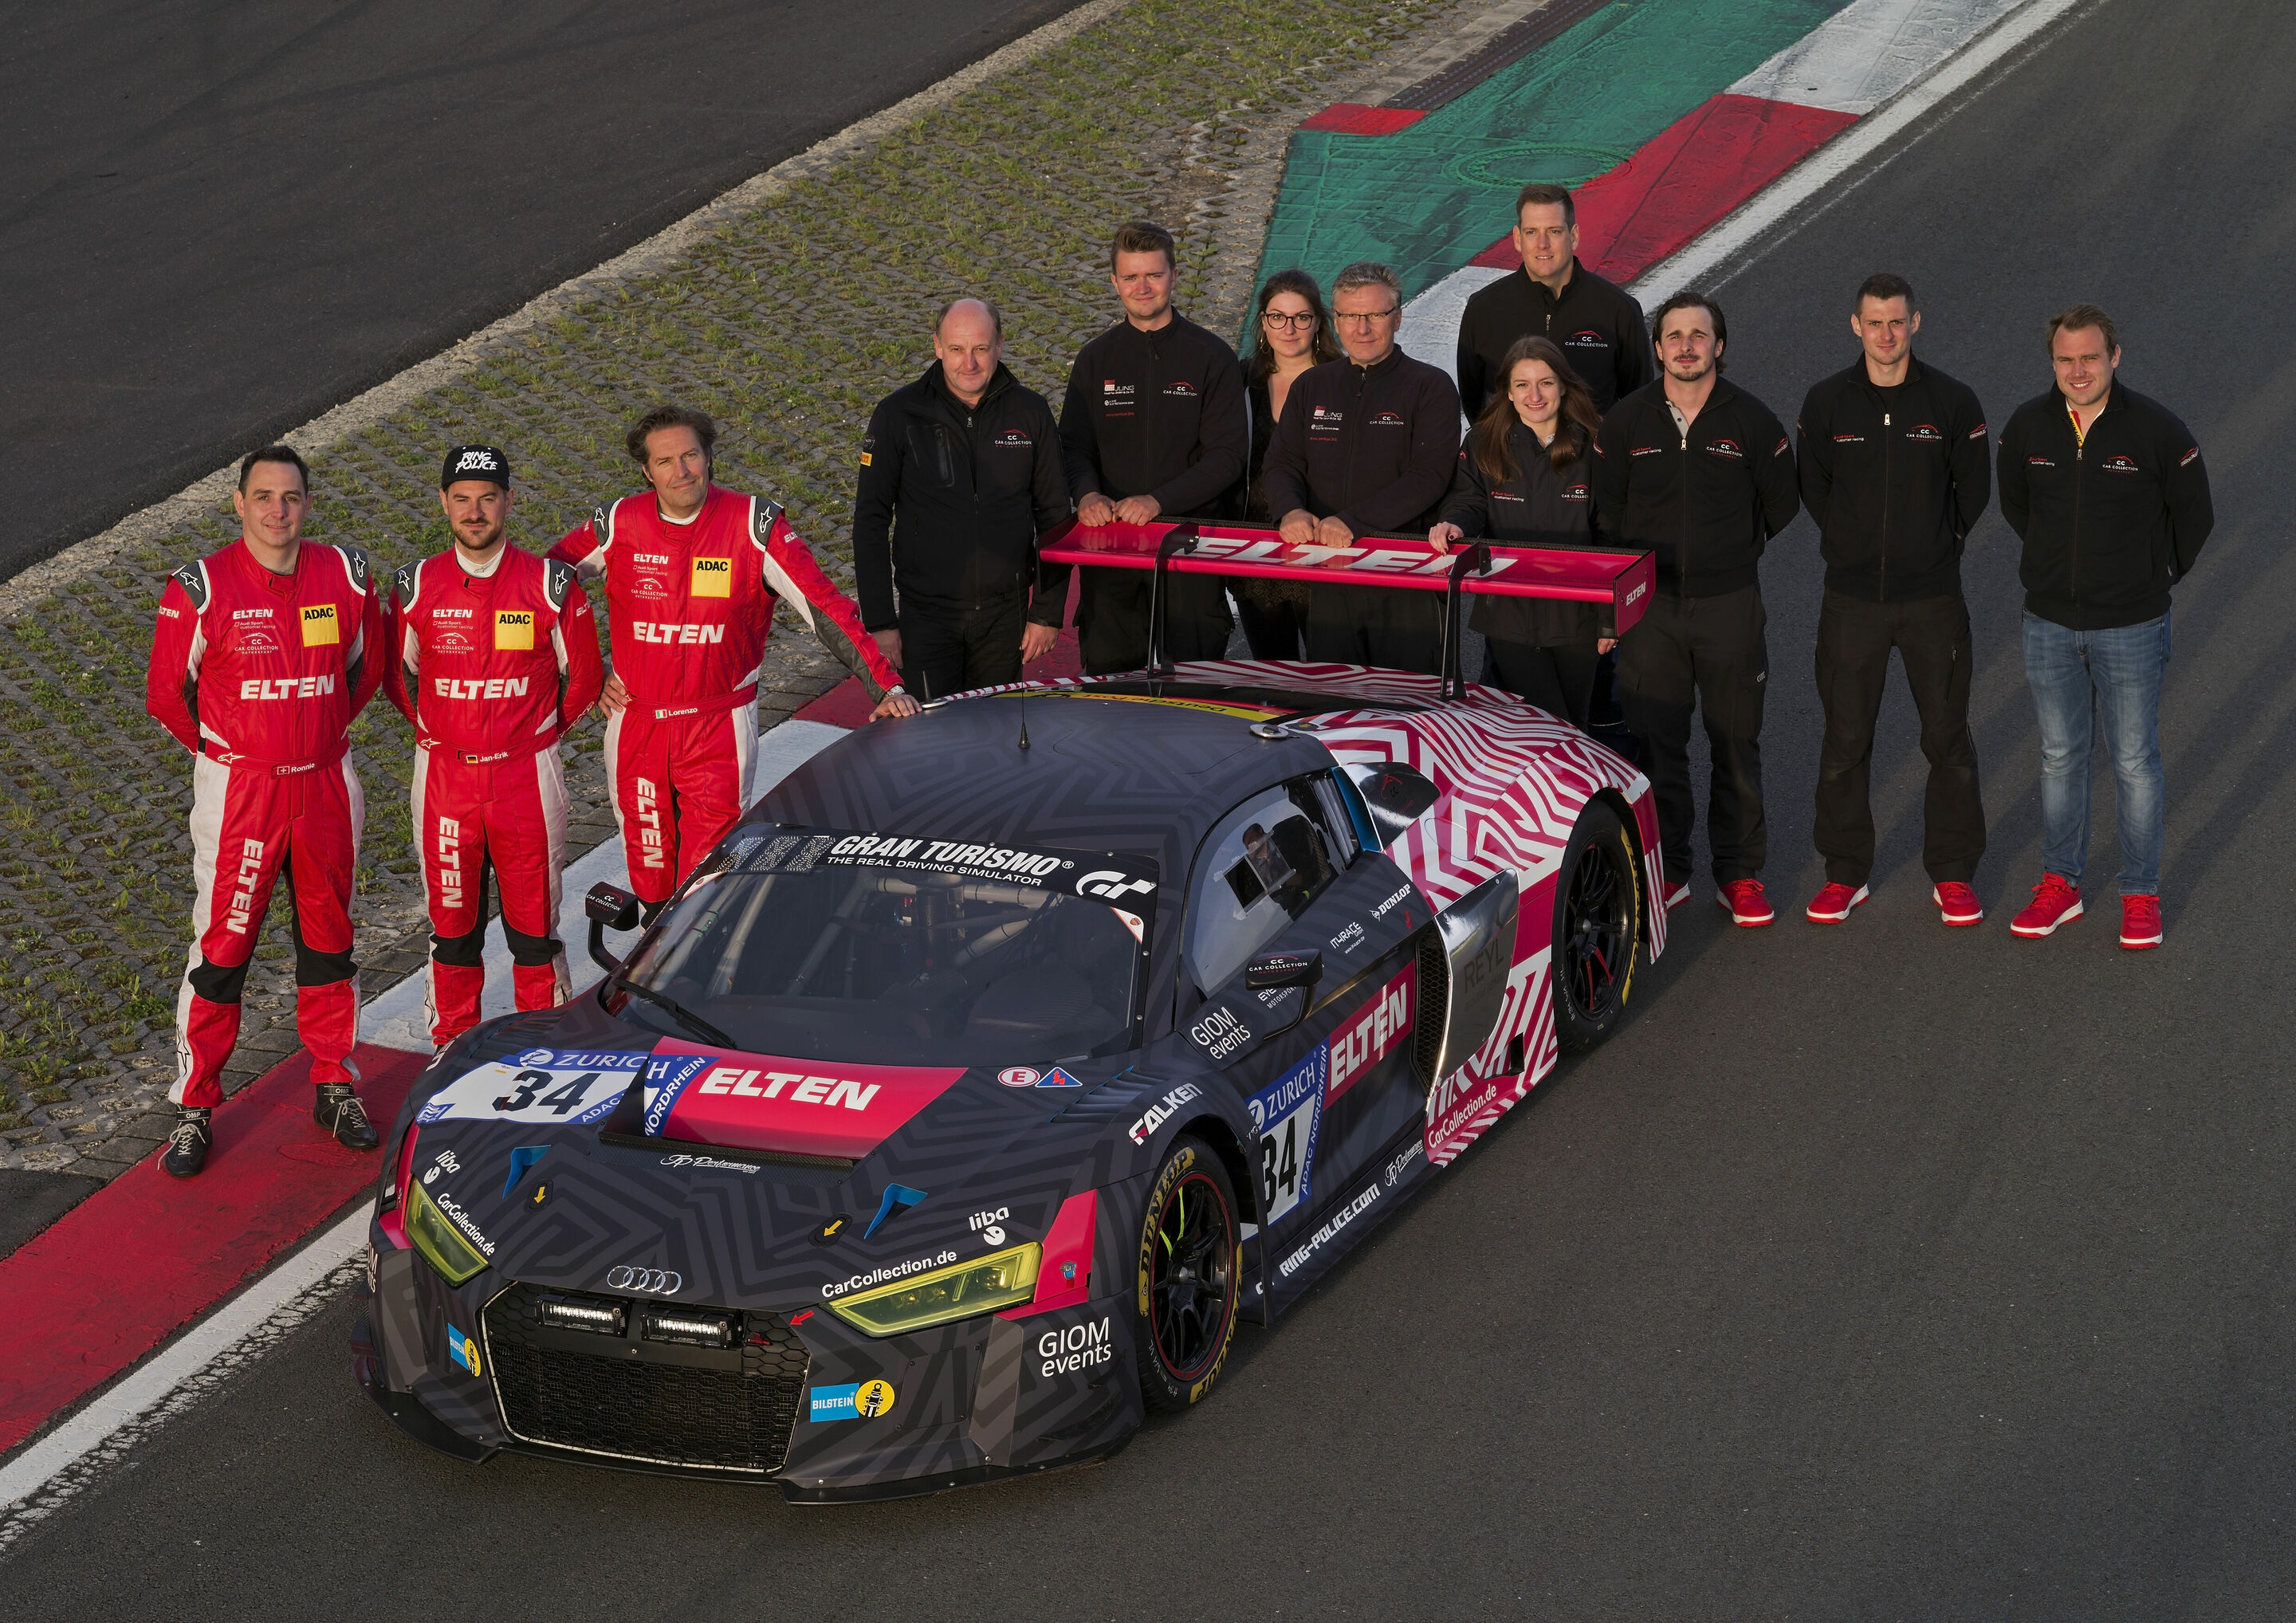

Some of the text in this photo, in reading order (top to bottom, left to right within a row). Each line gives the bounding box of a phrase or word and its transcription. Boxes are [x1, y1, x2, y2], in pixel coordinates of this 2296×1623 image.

[461, 451, 492, 463] RING
[1716, 448, 1743, 457] COLLECTION
[455, 460, 497, 474] POLICE
[633, 553, 669, 564] ELTEN
[696, 560, 729, 572] ADAC
[1626, 581, 1646, 607] ELTEN
[233, 609, 273, 620] ELTEN
[304, 607, 334, 621] ADAC
[433, 609, 473, 618] ELTEN
[498, 614, 531, 625] ADAC
[633, 621, 725, 644] ELTEN
[240, 674, 335, 700] ELTEN
[434, 677, 529, 700] ELTEN
[668, 706, 698, 717] Lorenzo
[291, 763, 315, 773] Ronnie
[479, 751, 509, 762] Jan-Erik
[637, 777, 664, 868] ELTEN
[830, 835, 914, 859] GRAN
[438, 815, 462, 908] ELTEN
[827, 856, 1042, 886] THE REAL DRIVING SIMULATOR
[226, 838, 265, 934] ELTEN
[1378, 883, 1411, 914] DUNLOP
[596, 898, 621, 911] COLLECTION
[1191, 1006, 1237, 1046] GIOM
[1331, 981, 1407, 1091] ELTEN
[1209, 1024, 1251, 1059] events
[553, 1054, 671, 1079] ZURICH
[491, 1070, 602, 1115] 34
[580, 1057, 706, 1136] ADAC NORDRHEIN
[698, 1067, 882, 1111] ELTEN
[1267, 1062, 1316, 1119] ZURICH
[1128, 1083, 1203, 1146] FALKEN
[1300, 1044, 1327, 1195] ADAC NORDRHEIN
[1428, 1083, 1497, 1149] CarCollection.de
[435, 1149, 461, 1174] liba
[693, 1157, 761, 1172] Performance
[1260, 1115, 1297, 1214] 34
[437, 1193, 496, 1257] CarCollection.de
[968, 1206, 1010, 1232] liba
[1140, 1150, 1189, 1274] DUNLOP
[1279, 1183, 1381, 1277] RING-POLICE.COM
[821, 1251, 957, 1298] CarCollection.de
[1038, 1317, 1110, 1358] GIOM
[1041, 1342, 1111, 1377] events
[812, 1396, 854, 1410] BILSTEIN
